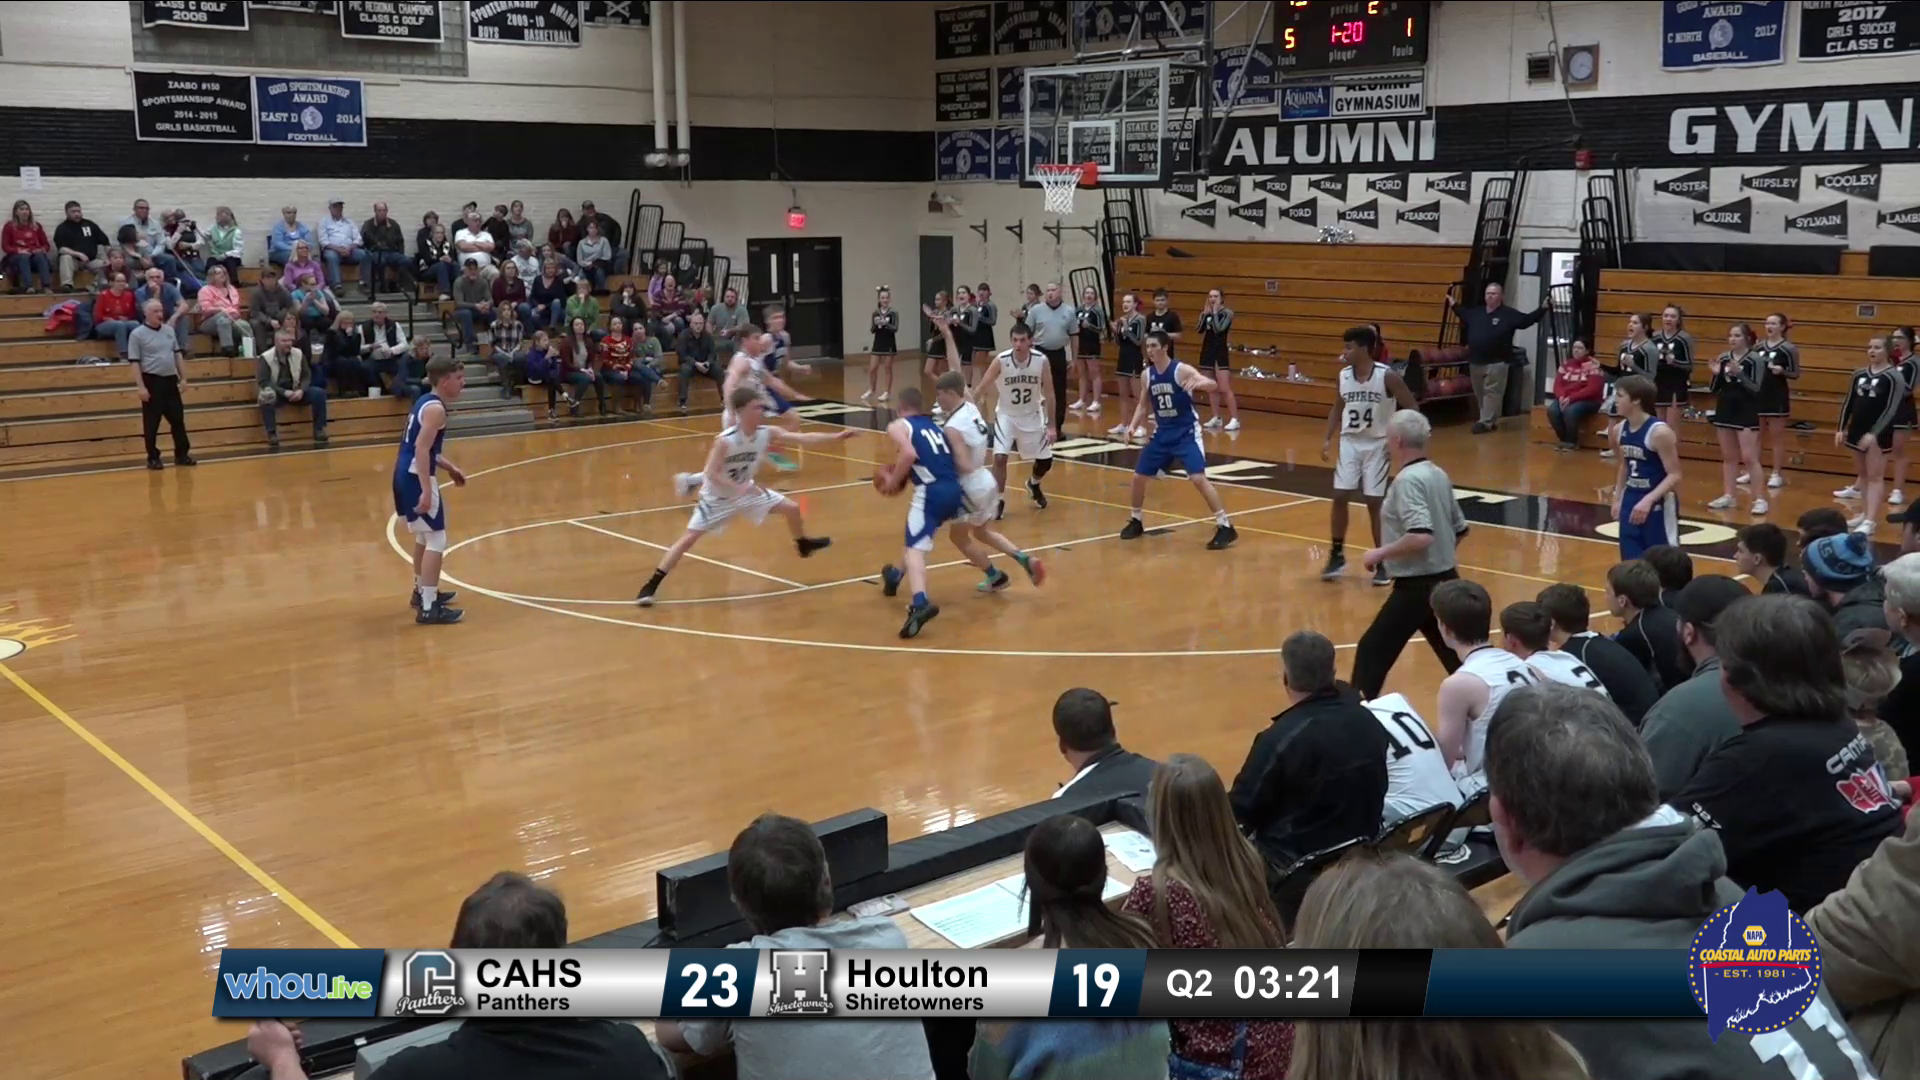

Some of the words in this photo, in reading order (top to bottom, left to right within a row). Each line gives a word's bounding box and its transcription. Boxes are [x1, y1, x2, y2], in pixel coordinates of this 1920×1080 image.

[201, 2, 226, 13] GOLF
[1330, 3, 1359, 18] period
[1702, 5, 1743, 18] AWARD
[360, 14, 391, 23] CLASS
[402, 17, 425, 26] GOLF
[471, 1, 539, 24] SPORTSMANSHIP
[550, 3, 579, 29] AWARD
[1838, 6, 1887, 22] 2017
[378, 25, 409, 35] 2009
[478, 25, 500, 39] BOYS
[523, 29, 574, 43] BASKETBALL
[1754, 24, 1777, 37] 2017
[1826, 25, 1853, 39] GIRLS
[1859, 21, 1897, 35] SOCCER
[1284, 28, 1295, 49] 5
[1392, 45, 1414, 57] fouls
[1826, 39, 1879, 53] CLASS
[1883, 37, 1895, 49] C
[1278, 54, 1297, 66] fouls
[1329, 49, 1357, 63] player
[1692, 52, 1749, 62] BASEBALL
[289, 82, 350, 98] SPORTSMANSHIP
[142, 95, 214, 107] SPORTSMANSHIP
[216, 98, 247, 111] AWARD
[292, 93, 329, 104] AWARD
[1335, 93, 1420, 113] GYMNASIUM
[174, 111, 193, 119] 2014
[199, 112, 218, 120] 2015
[261, 112, 289, 122] EAST
[291, 113, 299, 123] D
[336, 114, 361, 124] 2014
[155, 123, 182, 132] GIRLS
[183, 124, 238, 134] BASKETBALL
[1126, 121, 1150, 132] STATE
[1669, 98, 1920, 155] GYMN
[287, 133, 338, 141] FOOTBALL
[1224, 120, 1436, 166] ALUMNI
[1266, 182, 1288, 191] FORD
[1320, 181, 1342, 190] SHAW
[1376, 180, 1402, 190] FORD
[1434, 180, 1467, 191] DRAKE
[1669, 181, 1709, 192] FOSTER
[1752, 178, 1799, 189] HIPSLEY
[1824, 174, 1879, 188] COOLEY
[1238, 207, 1264, 217] HARRIS
[1289, 208, 1312, 218] FORD
[1345, 210, 1376, 220] DRAKE
[1404, 211, 1440, 221] PEABODY
[1703, 212, 1742, 224] QUIRK
[1795, 215, 1842, 228] SYLVAIN
[1004, 374, 1039, 386] SHIRES
[1011, 388, 1032, 405] 32
[1157, 394, 1173, 409] 20
[1343, 390, 1382, 404] SHIRES
[1348, 408, 1373, 428] 24
[920, 428, 951, 455] 14
[1629, 459, 1639, 477] 2
[1390, 711, 1436, 761] 10
